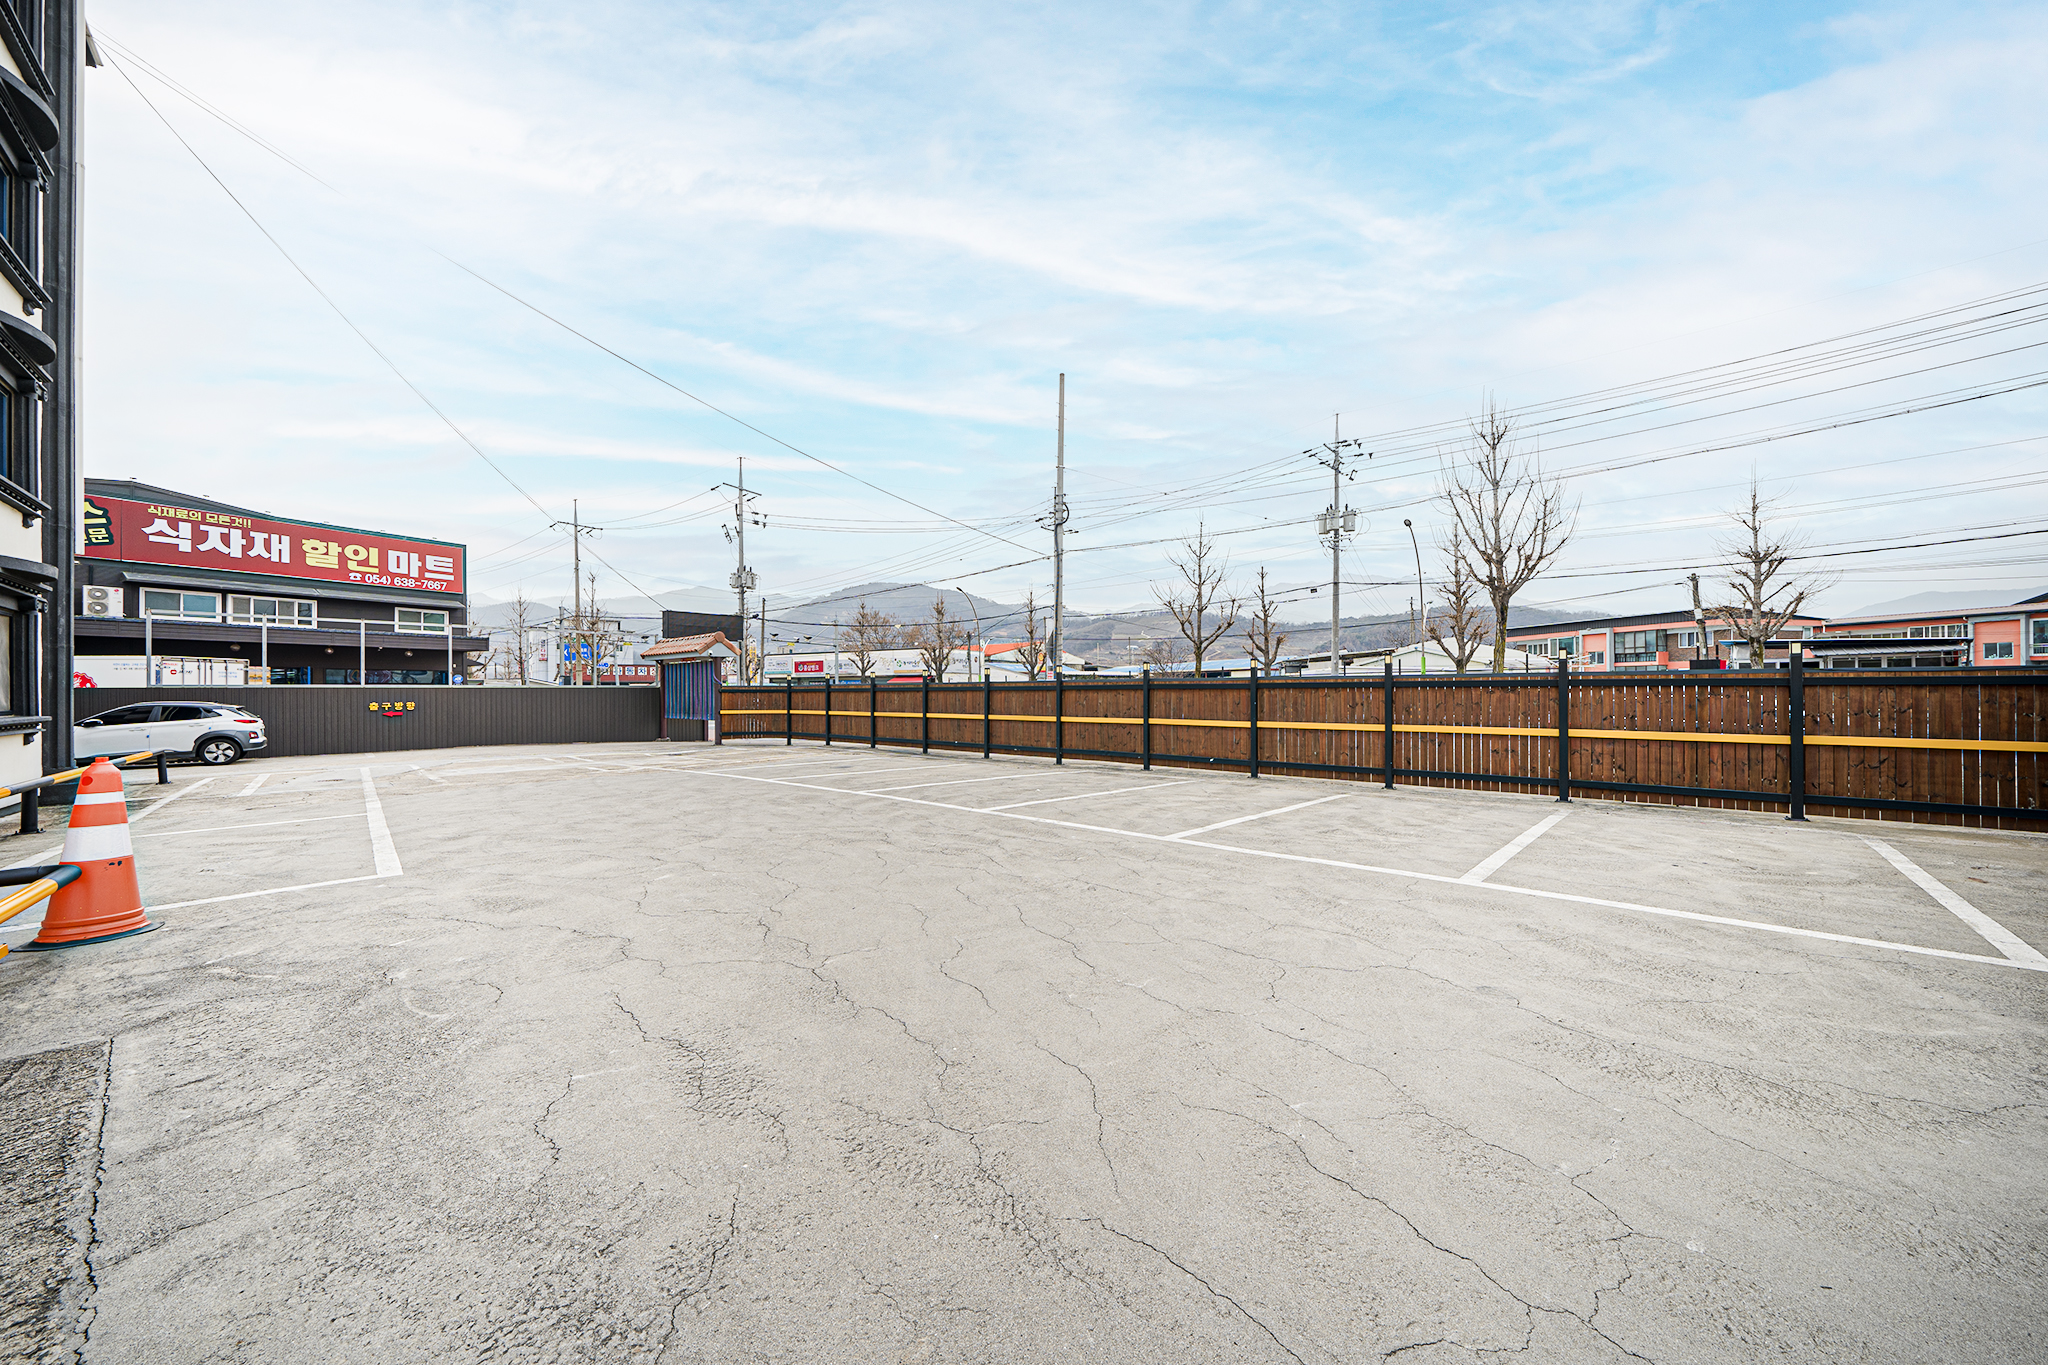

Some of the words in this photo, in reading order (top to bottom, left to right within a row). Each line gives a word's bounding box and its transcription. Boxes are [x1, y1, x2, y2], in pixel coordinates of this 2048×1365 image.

[147, 505, 202, 521] 식재료의
[205, 512, 252, 529] 모든것!!
[141, 518, 290, 564] 식자재
[301, 538, 379, 573] 할인
[387, 549, 455, 581] 마트
[364, 573, 391, 585] 054)
[393, 578, 447, 591] 638-7667
